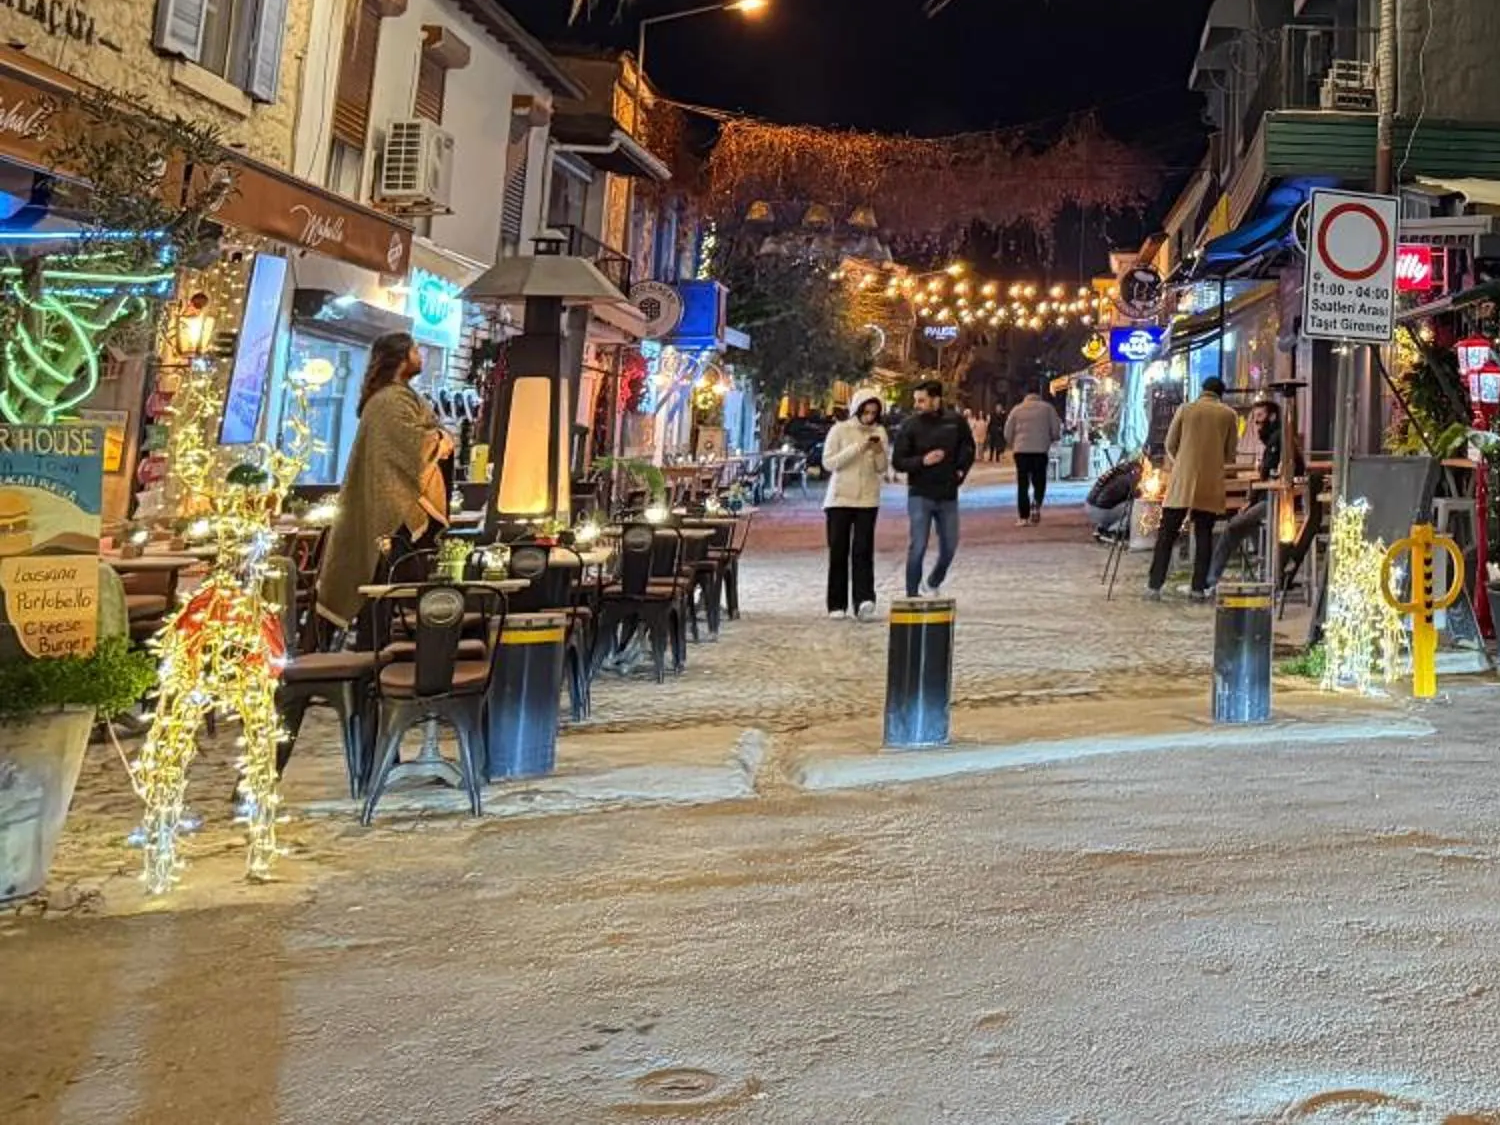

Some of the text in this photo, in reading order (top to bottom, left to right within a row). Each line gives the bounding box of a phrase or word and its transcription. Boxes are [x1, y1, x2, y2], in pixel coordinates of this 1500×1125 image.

[1313, 282, 1345, 296] 11:00
[1355, 286, 1389, 300] 04:00
[1311, 298, 1355, 315] Saatleri
[1310, 315, 1388, 334] Taşıt Giremez
[19, 428, 97, 455] HOUSE
[39, 636, 91, 653] Burger
